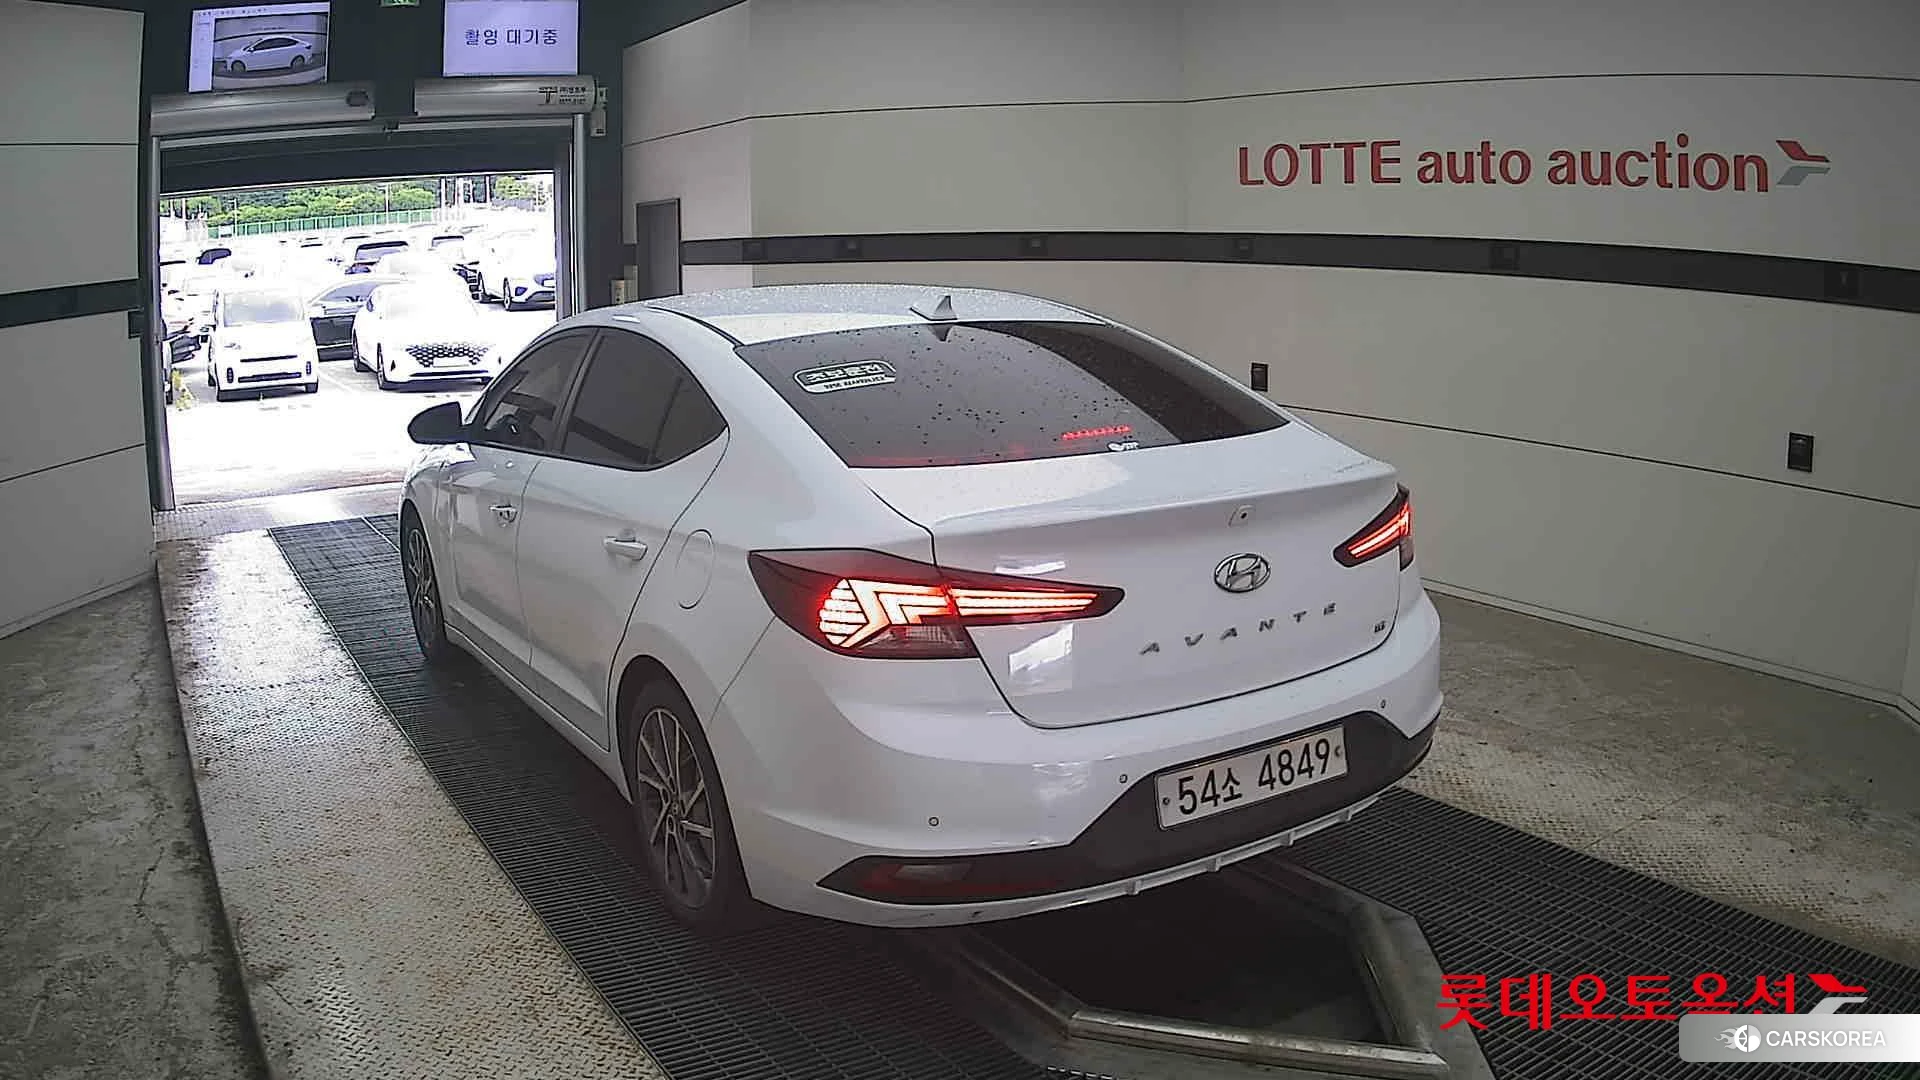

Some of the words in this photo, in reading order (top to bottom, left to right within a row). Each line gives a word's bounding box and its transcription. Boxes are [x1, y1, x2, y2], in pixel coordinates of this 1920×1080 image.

[465, 29, 499, 45] 촬영
[506, 29, 558, 45] 대기중
[1239, 140, 1401, 187] LOTTE
[1417, 141, 1532, 185] auto
[1547, 134, 1769, 193] auction
[1139, 602, 1336, 655] AVANTE
[1178, 767, 1243, 815] 54소
[1258, 738, 1330, 791] 4849
